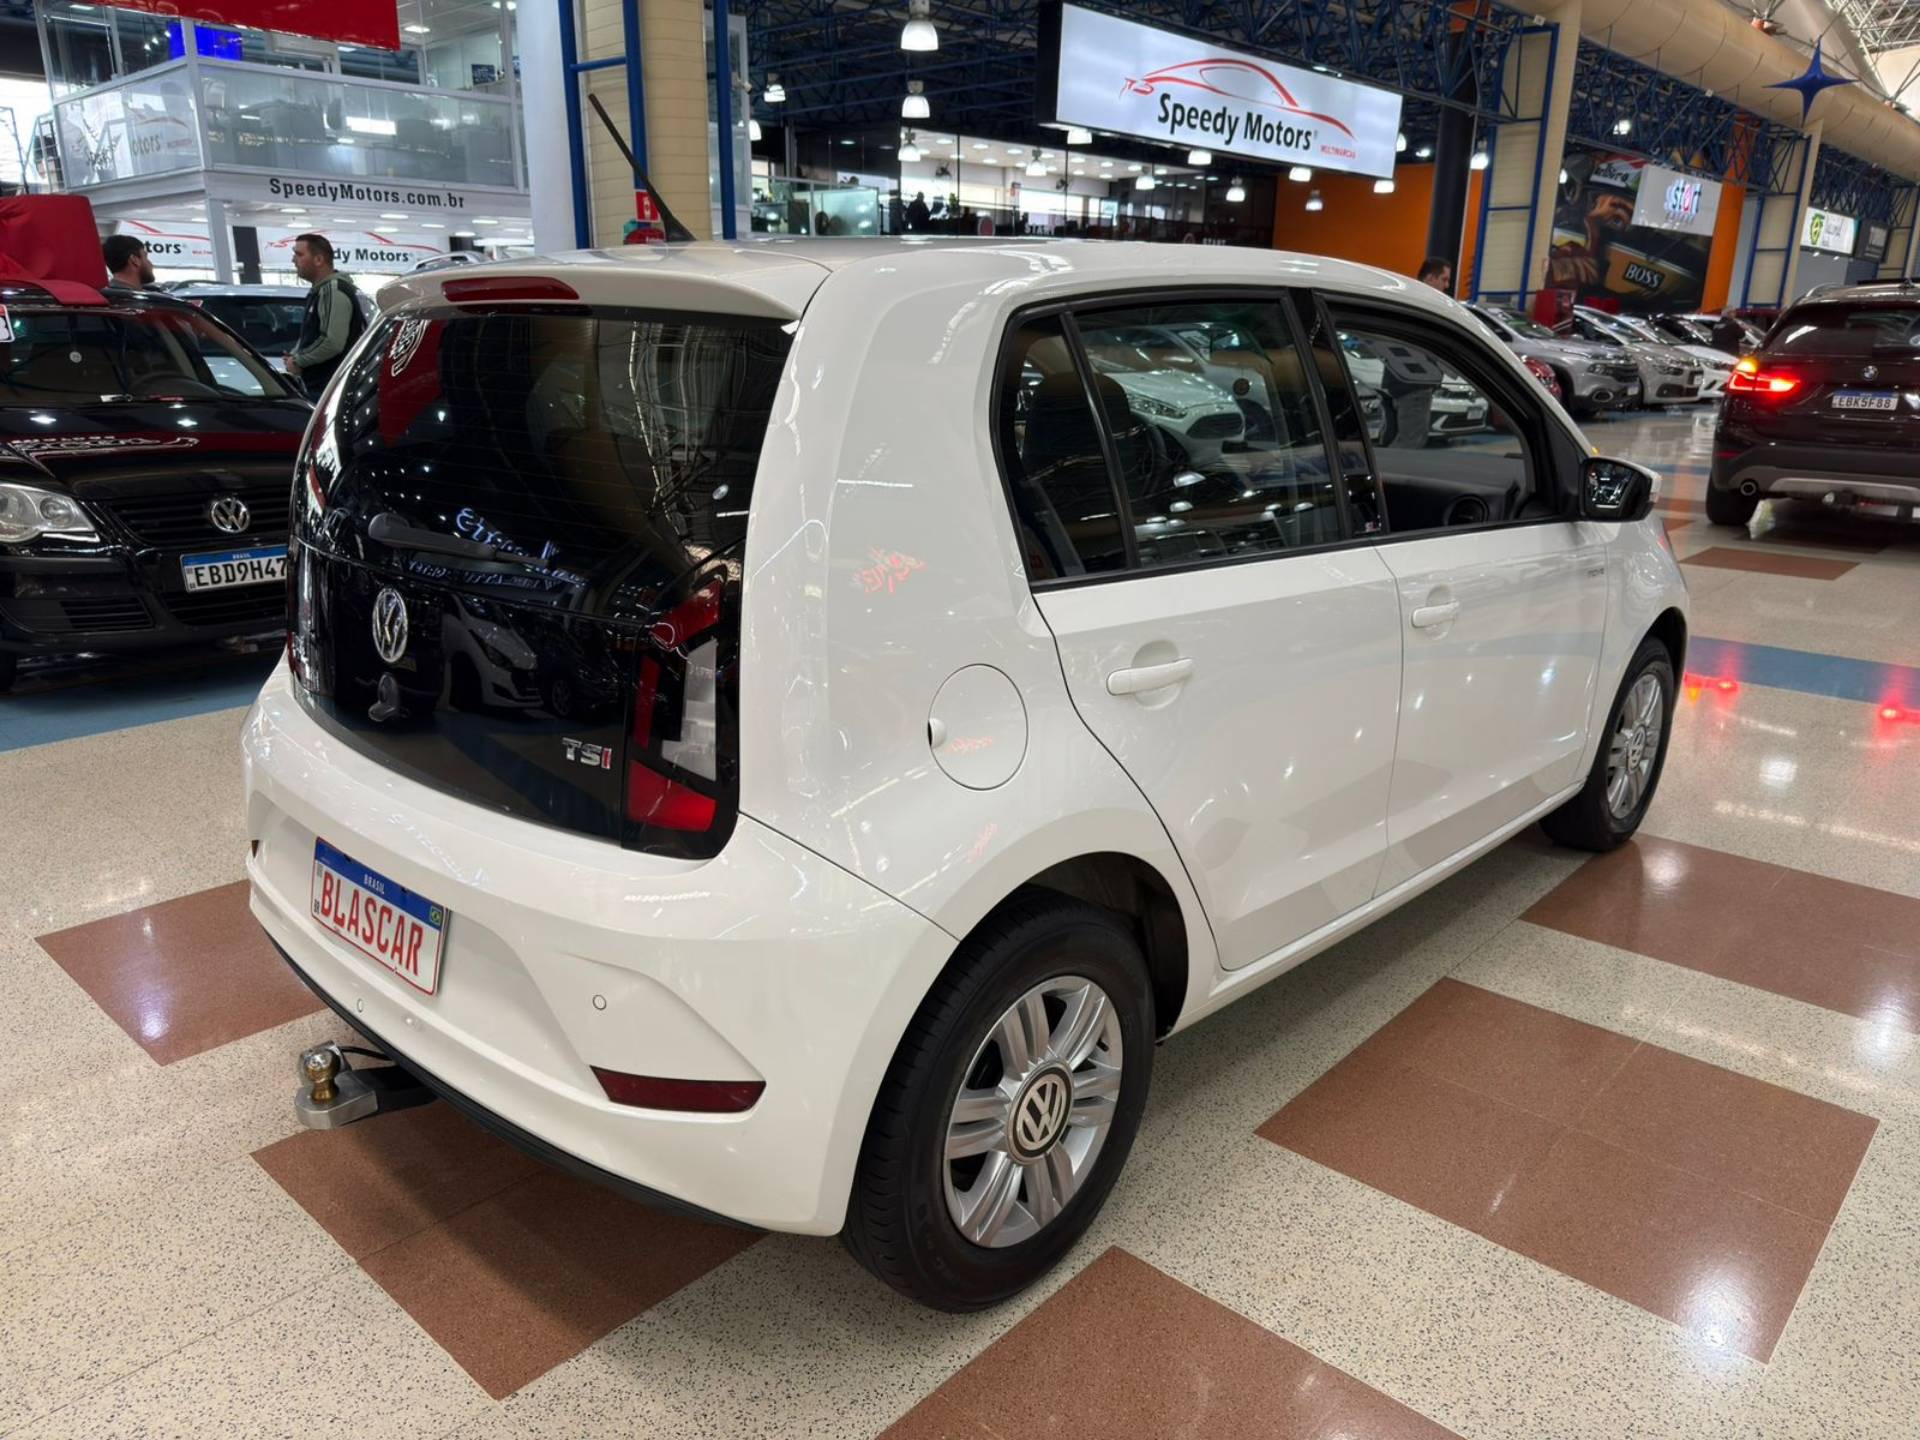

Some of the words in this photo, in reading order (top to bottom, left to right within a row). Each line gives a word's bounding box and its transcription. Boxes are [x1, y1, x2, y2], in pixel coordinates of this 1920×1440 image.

[1158, 92, 1240, 146] Speedy
[1244, 112, 1313, 151] Motors
[270, 178, 465, 208] SpeedyMotors.com.br
[356, 248, 409, 262] Motors
[1625, 263, 1660, 288] BOSS
[194, 558, 288, 587] EBD9H47
[363, 873, 385, 895] BRASIL
[321, 870, 424, 977] BLASCAR
